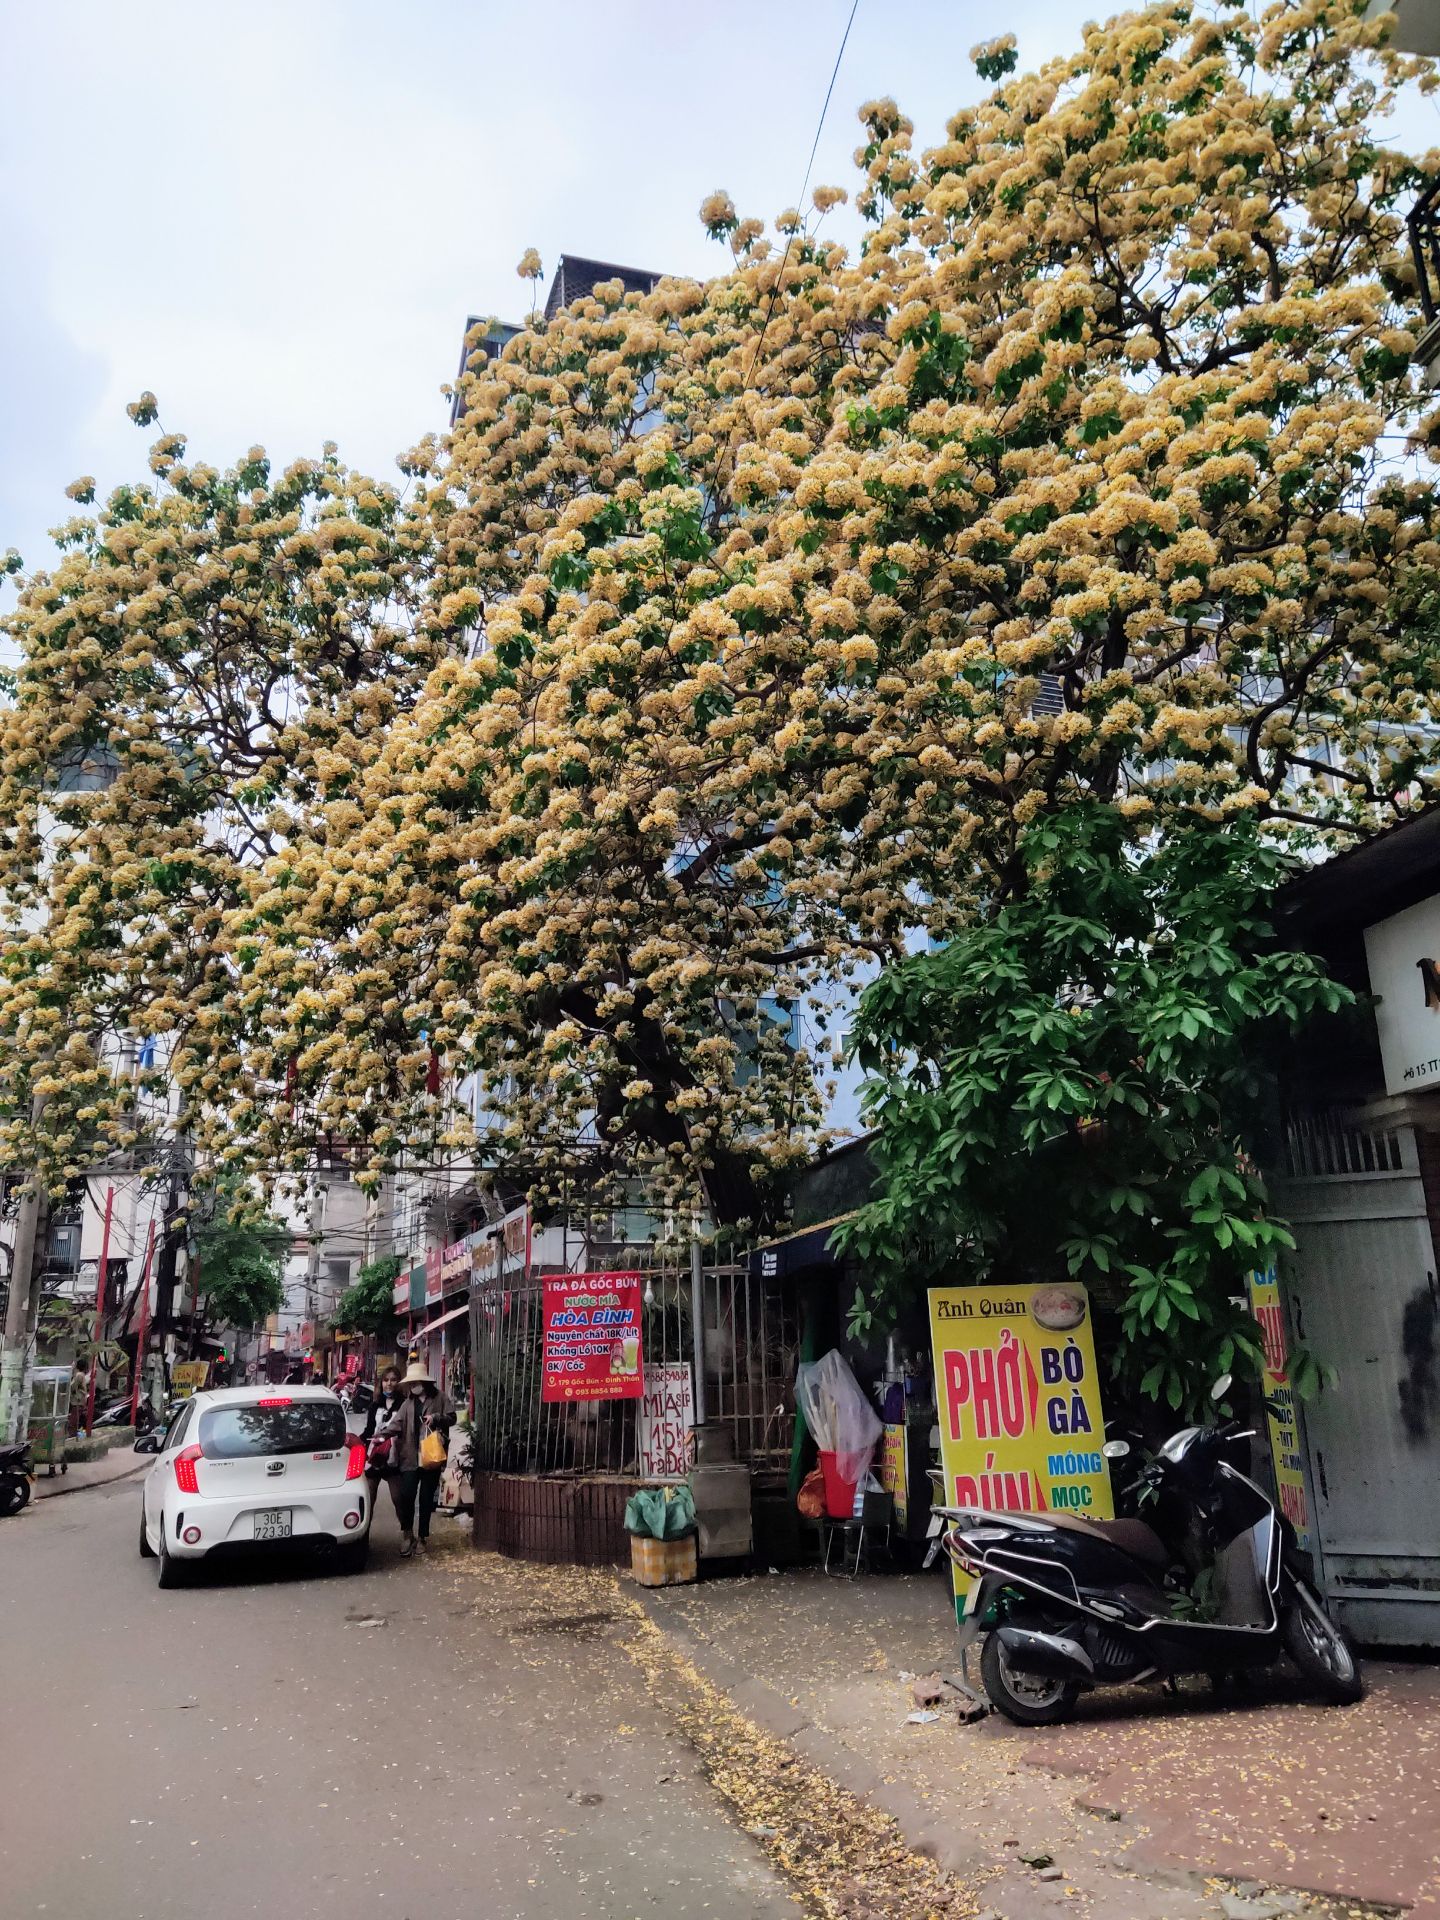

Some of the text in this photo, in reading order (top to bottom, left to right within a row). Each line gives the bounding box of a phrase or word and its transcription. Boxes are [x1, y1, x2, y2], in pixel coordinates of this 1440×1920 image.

[1416, 1063, 1426, 1076] 15
[547, 1276, 638, 1291] TRÀ ĐÁ GỐC BÚN
[564, 1293, 620, 1307] NƯỚC MÍA
[938, 1299, 1026, 1318] Anh Quân
[551, 1307, 634, 1326] HÒA BÌNH
[547, 1330, 582, 1342] Nguyên
[584, 1327, 604, 1340] chất
[593, 1344, 611, 1354] 10K
[566, 1358, 585, 1371] Cốc
[1040, 1337, 1084, 1385] BÒ
[943, 1328, 1025, 1440] PHỞ
[1047, 1388, 1092, 1434] GÀ
[1048, 1451, 1102, 1475] MÓNG
[1051, 1487, 1093, 1512] MỌC
[264, 1513, 282, 1525] 30E
